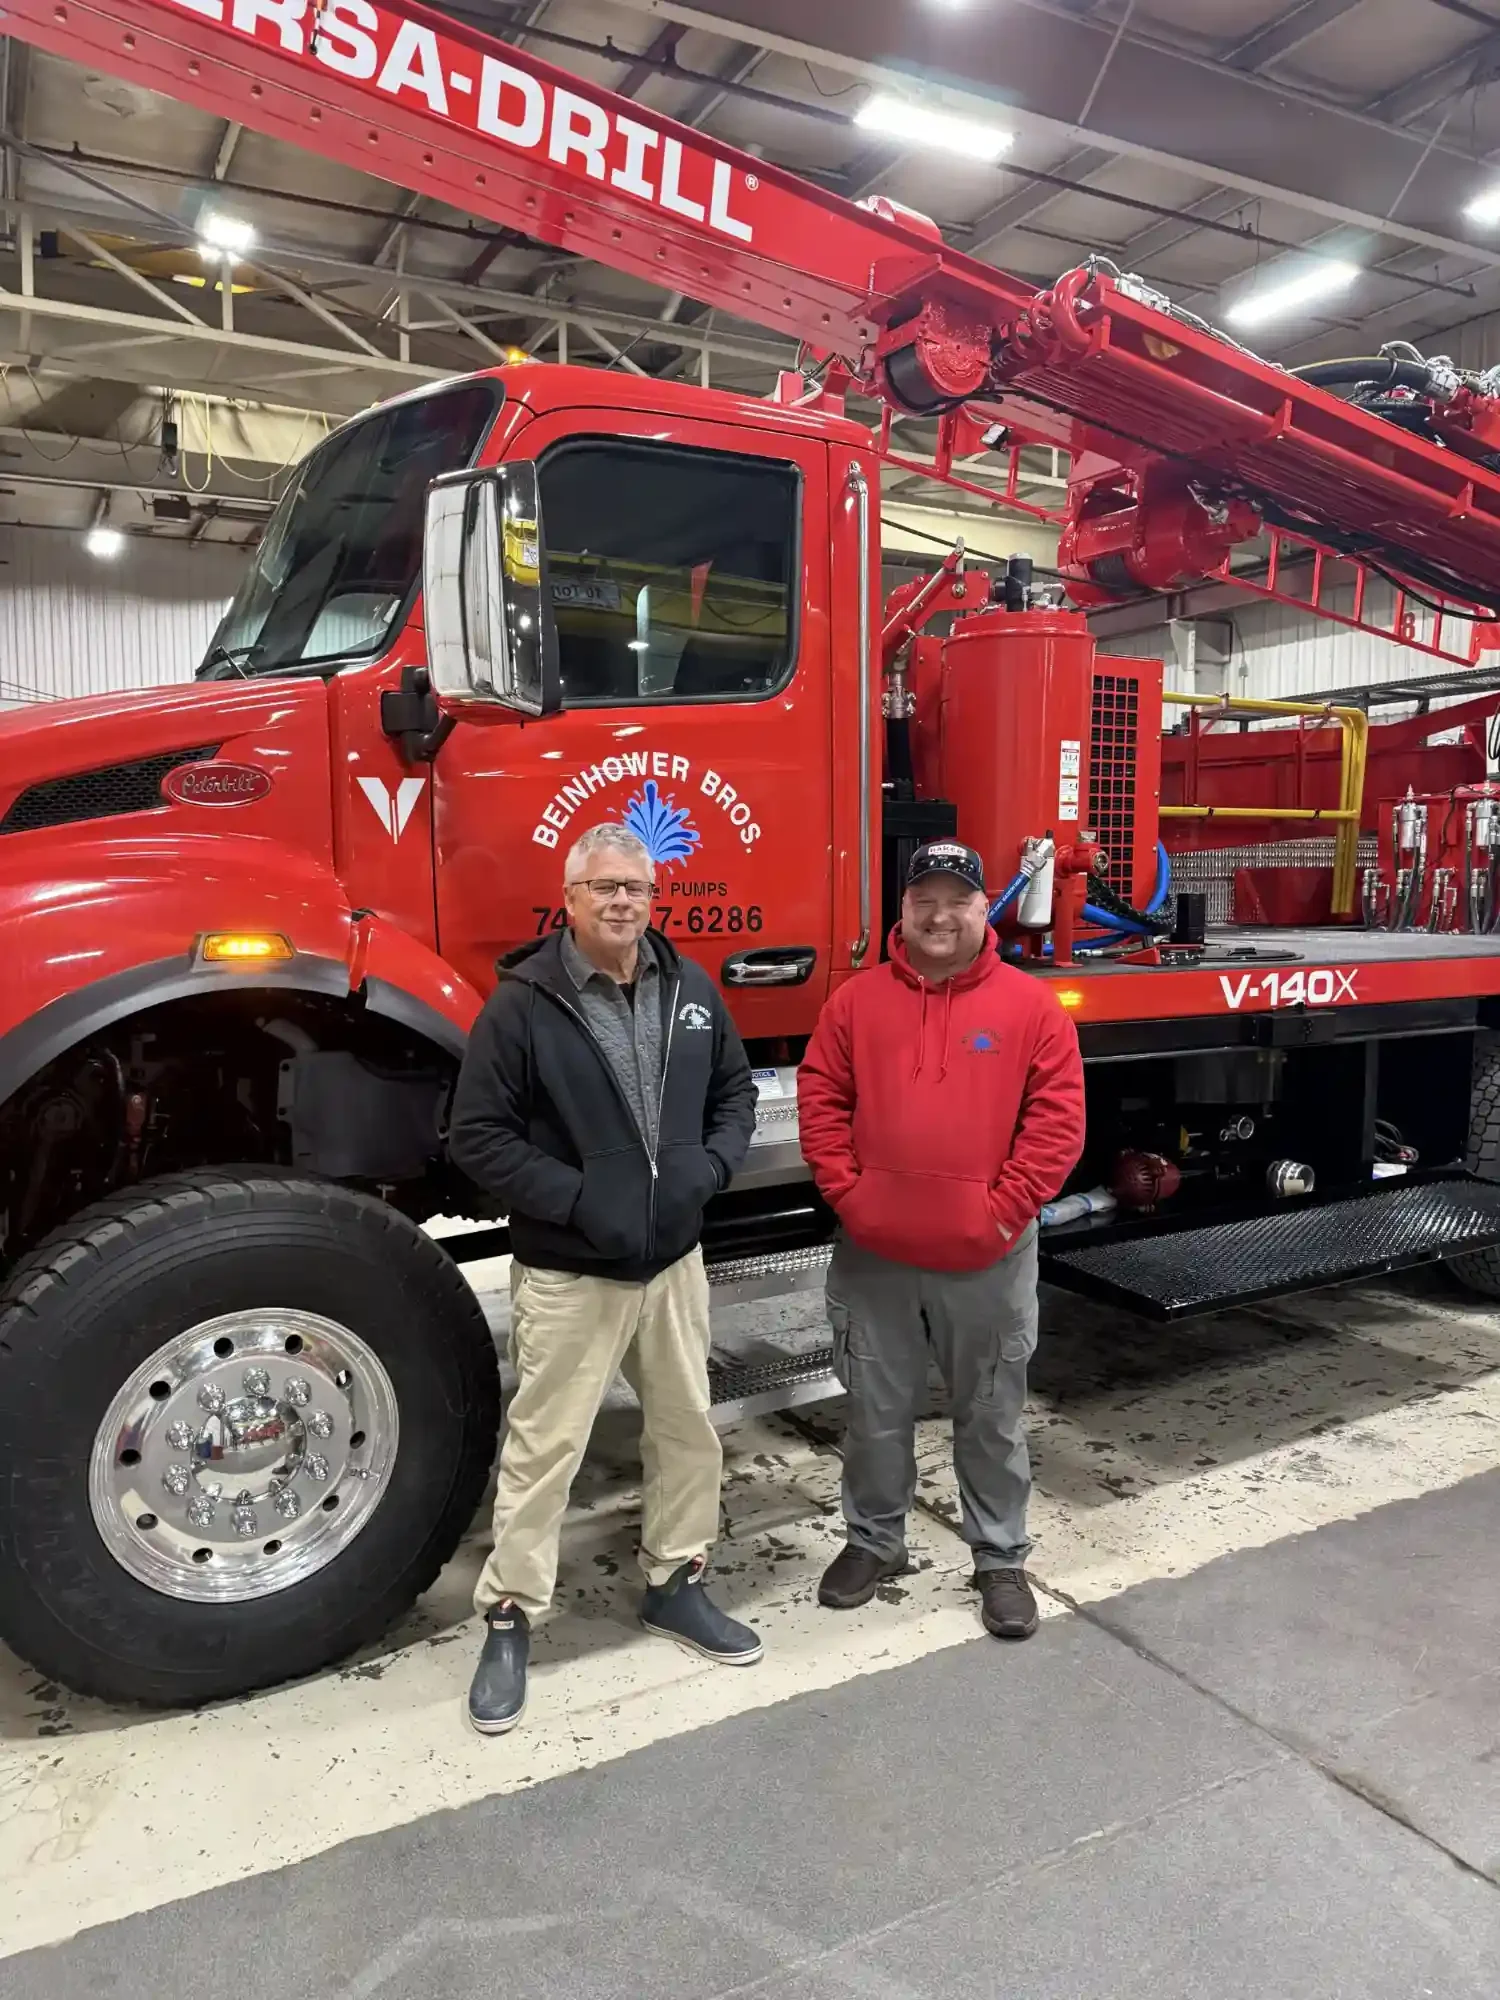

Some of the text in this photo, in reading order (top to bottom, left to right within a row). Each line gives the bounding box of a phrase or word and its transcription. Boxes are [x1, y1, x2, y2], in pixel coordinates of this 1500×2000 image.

[181, 774, 261, 796] Peterbilt
[532, 751, 761, 854] BEINHOWER BROS.
[670, 881, 728, 897] PUMPS
[1219, 968, 1358, 1009] V-140X
